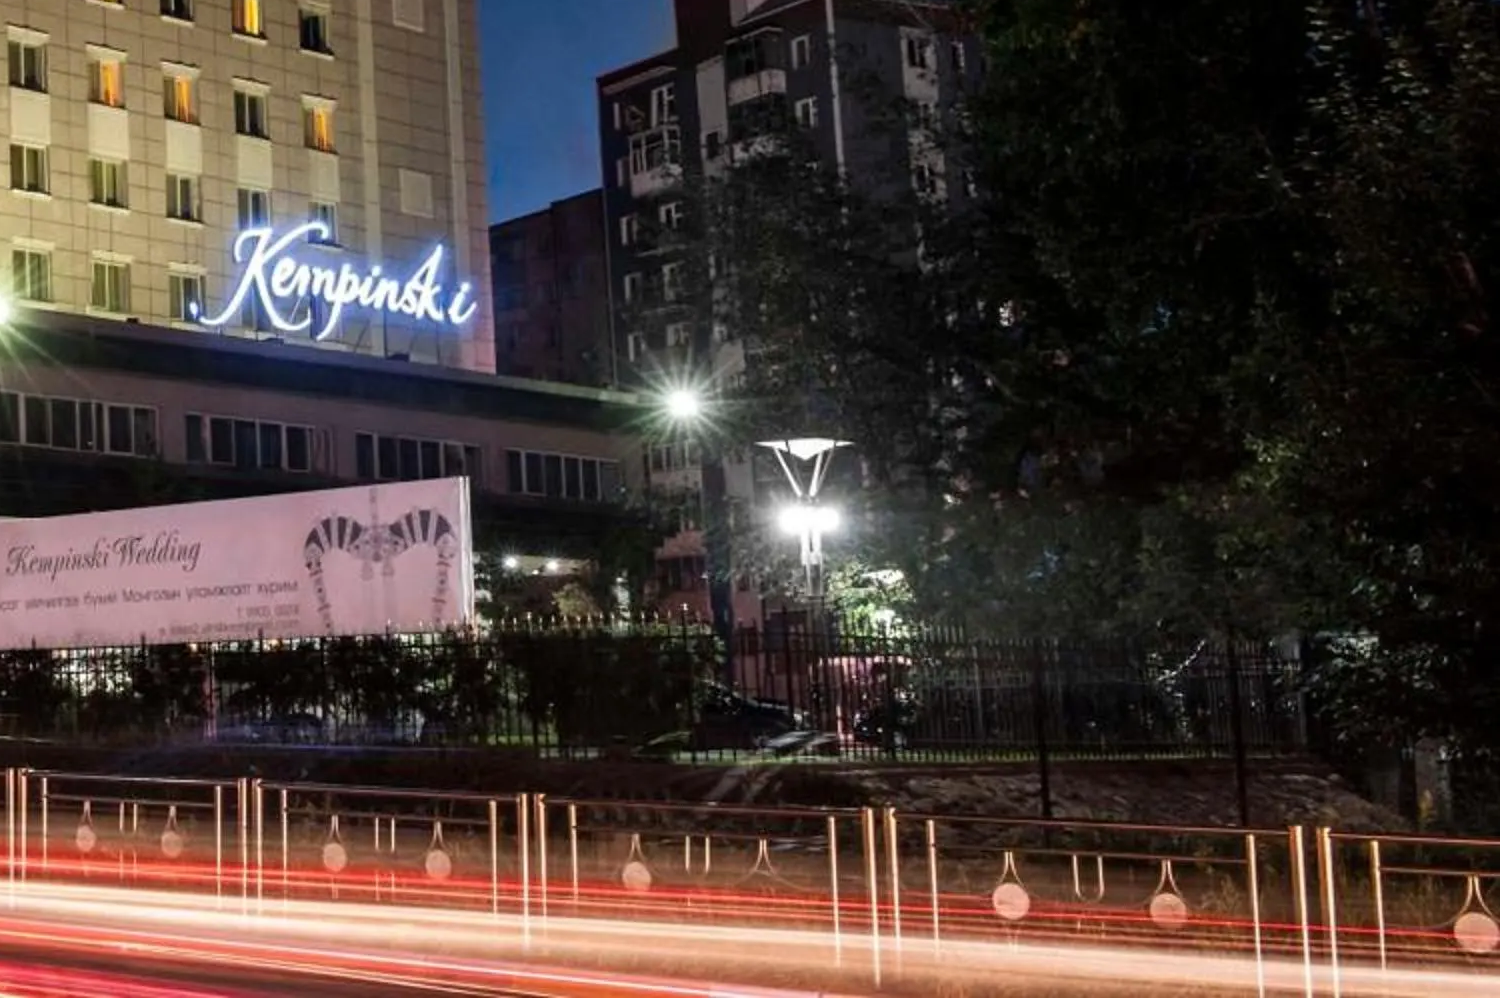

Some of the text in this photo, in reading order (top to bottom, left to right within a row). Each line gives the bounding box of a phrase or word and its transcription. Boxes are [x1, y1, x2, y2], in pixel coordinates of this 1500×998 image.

[189, 221, 477, 341] Kempinski
[5, 528, 203, 580] Kempinski Wedding
